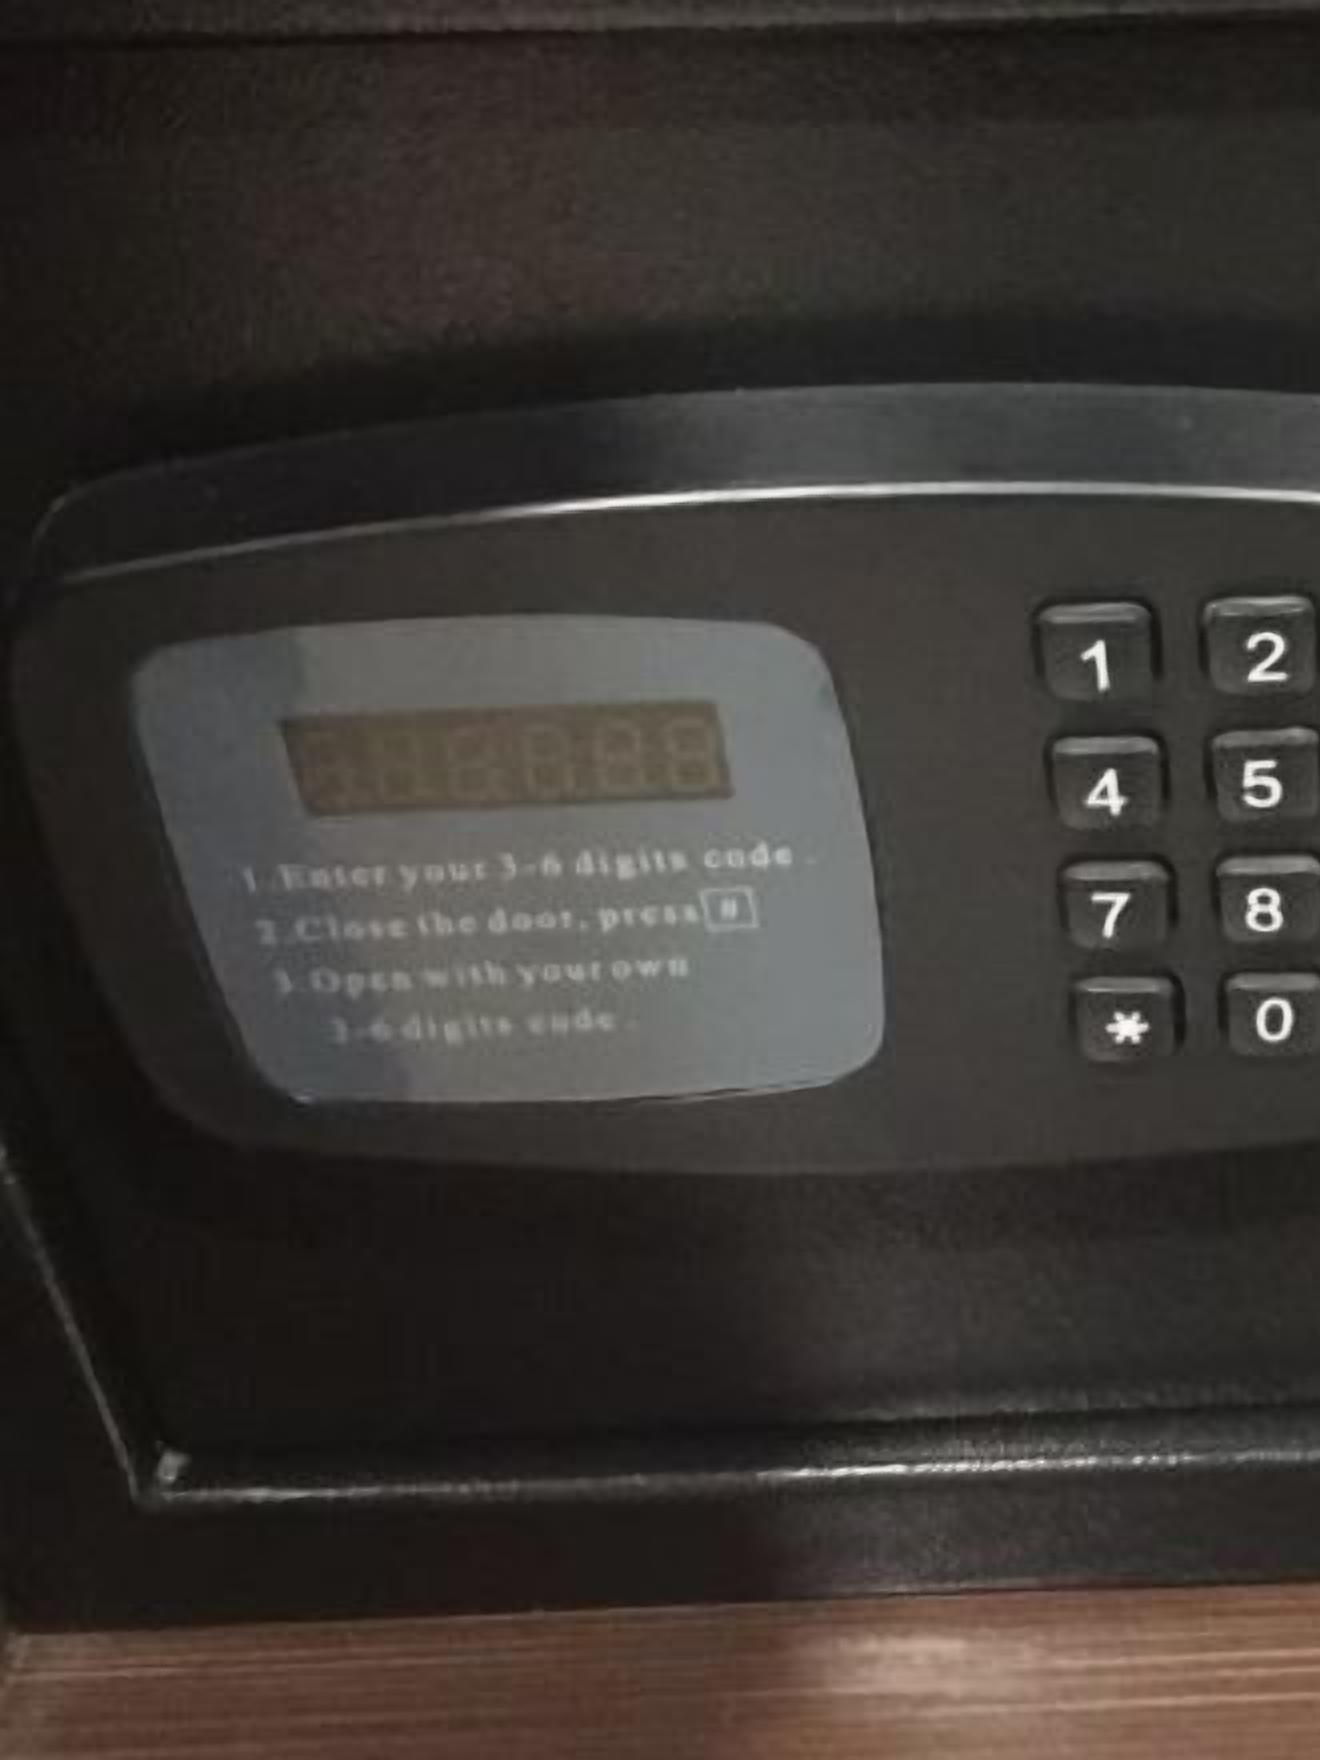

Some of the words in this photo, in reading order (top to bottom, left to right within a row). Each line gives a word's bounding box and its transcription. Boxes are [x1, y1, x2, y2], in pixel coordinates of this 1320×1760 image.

[1080, 639, 1111, 692] 1
[1246, 632, 1289, 682] 2
[1086, 768, 1127, 816] 4
[1242, 759, 1284, 808] 5
[576, 848, 689, 881] digits
[416, 909, 478, 938] the
[1091, 892, 1131, 939] 7
[1245, 887, 1284, 933] 8
[610, 958, 690, 982] own
[1256, 997, 1294, 1042] 0
